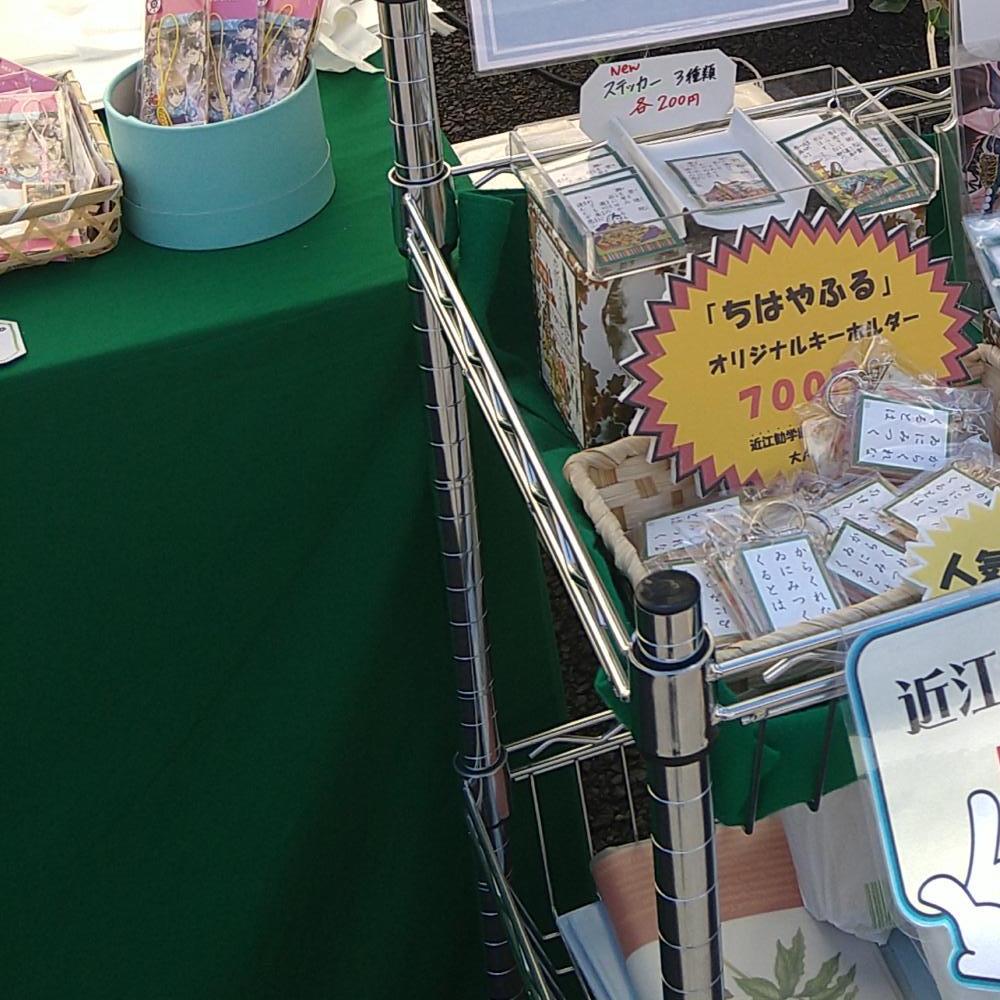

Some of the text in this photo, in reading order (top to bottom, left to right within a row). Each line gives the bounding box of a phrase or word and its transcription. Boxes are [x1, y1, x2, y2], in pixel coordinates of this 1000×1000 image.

[603, 63, 718, 99] ステッカー 3種類
[611, 63, 641, 77] New
[706, 269, 893, 329] 「ちはやふる」
[708, 310, 920, 375] オリジナルキーホルダー
[749, 429, 804, 453] 近江勧学
